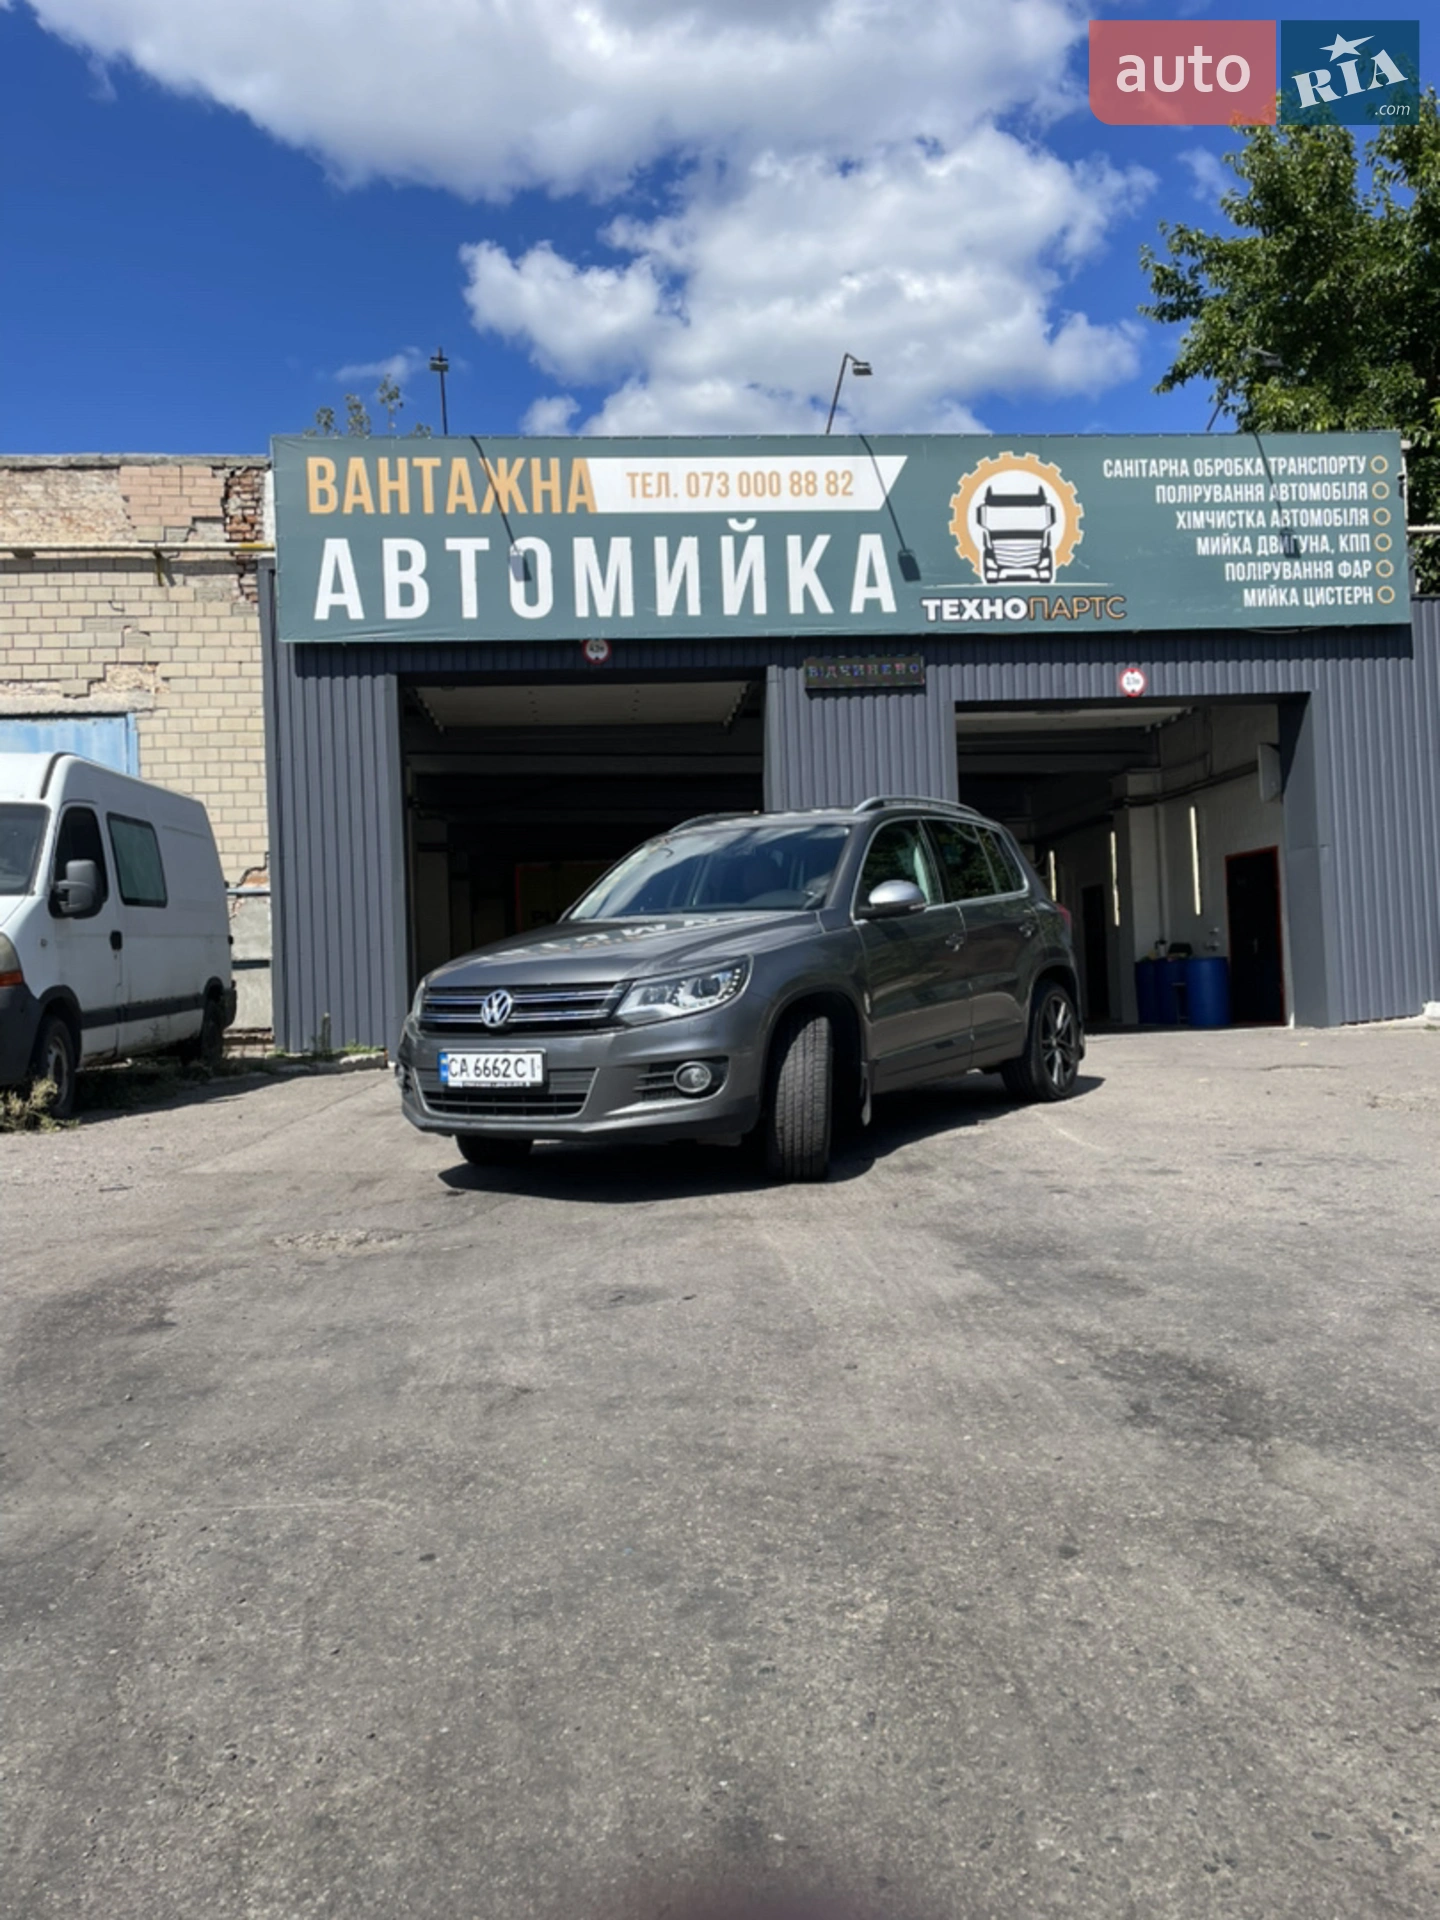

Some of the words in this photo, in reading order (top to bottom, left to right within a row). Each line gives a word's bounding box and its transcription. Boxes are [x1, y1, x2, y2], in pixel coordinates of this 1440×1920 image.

[1103, 458, 1190, 478] САНІТАРНА
[1193, 457, 1265, 477] ОБРОБКА
[1267, 455, 1367, 476] ТРАНСПОРТУ
[306, 457, 597, 515] ВАНТАЖНА
[626, 471, 678, 499] ТЕЛ.
[686, 471, 730, 498] 073
[737, 470, 781, 497] 000
[788, 469, 820, 497] 88
[825, 469, 854, 497] 82
[1155, 483, 1265, 504] ПОЛІРУВАННЯ
[1268, 481, 1369, 502] АВТОМОБІЛЯ
[1175, 510, 1266, 530] ХІМЧИСТКА
[1270, 508, 1370, 529] АВТОМОБІЛЯ
[1196, 532, 1252, 556] МИЙКА
[1338, 533, 1371, 553] КПП
[314, 517, 897, 620] АВТОМИЙКА
[1225, 561, 1334, 582] ПОЛІРУВАННЯ
[1338, 560, 1372, 580] ФАР
[1243, 583, 1300, 608] МИЙКА
[1303, 586, 1373, 608] ЦИСТЕРН
[921, 596, 1127, 622] ТЕХНОПАРТС
[474, 1057, 511, 1078] 6662
